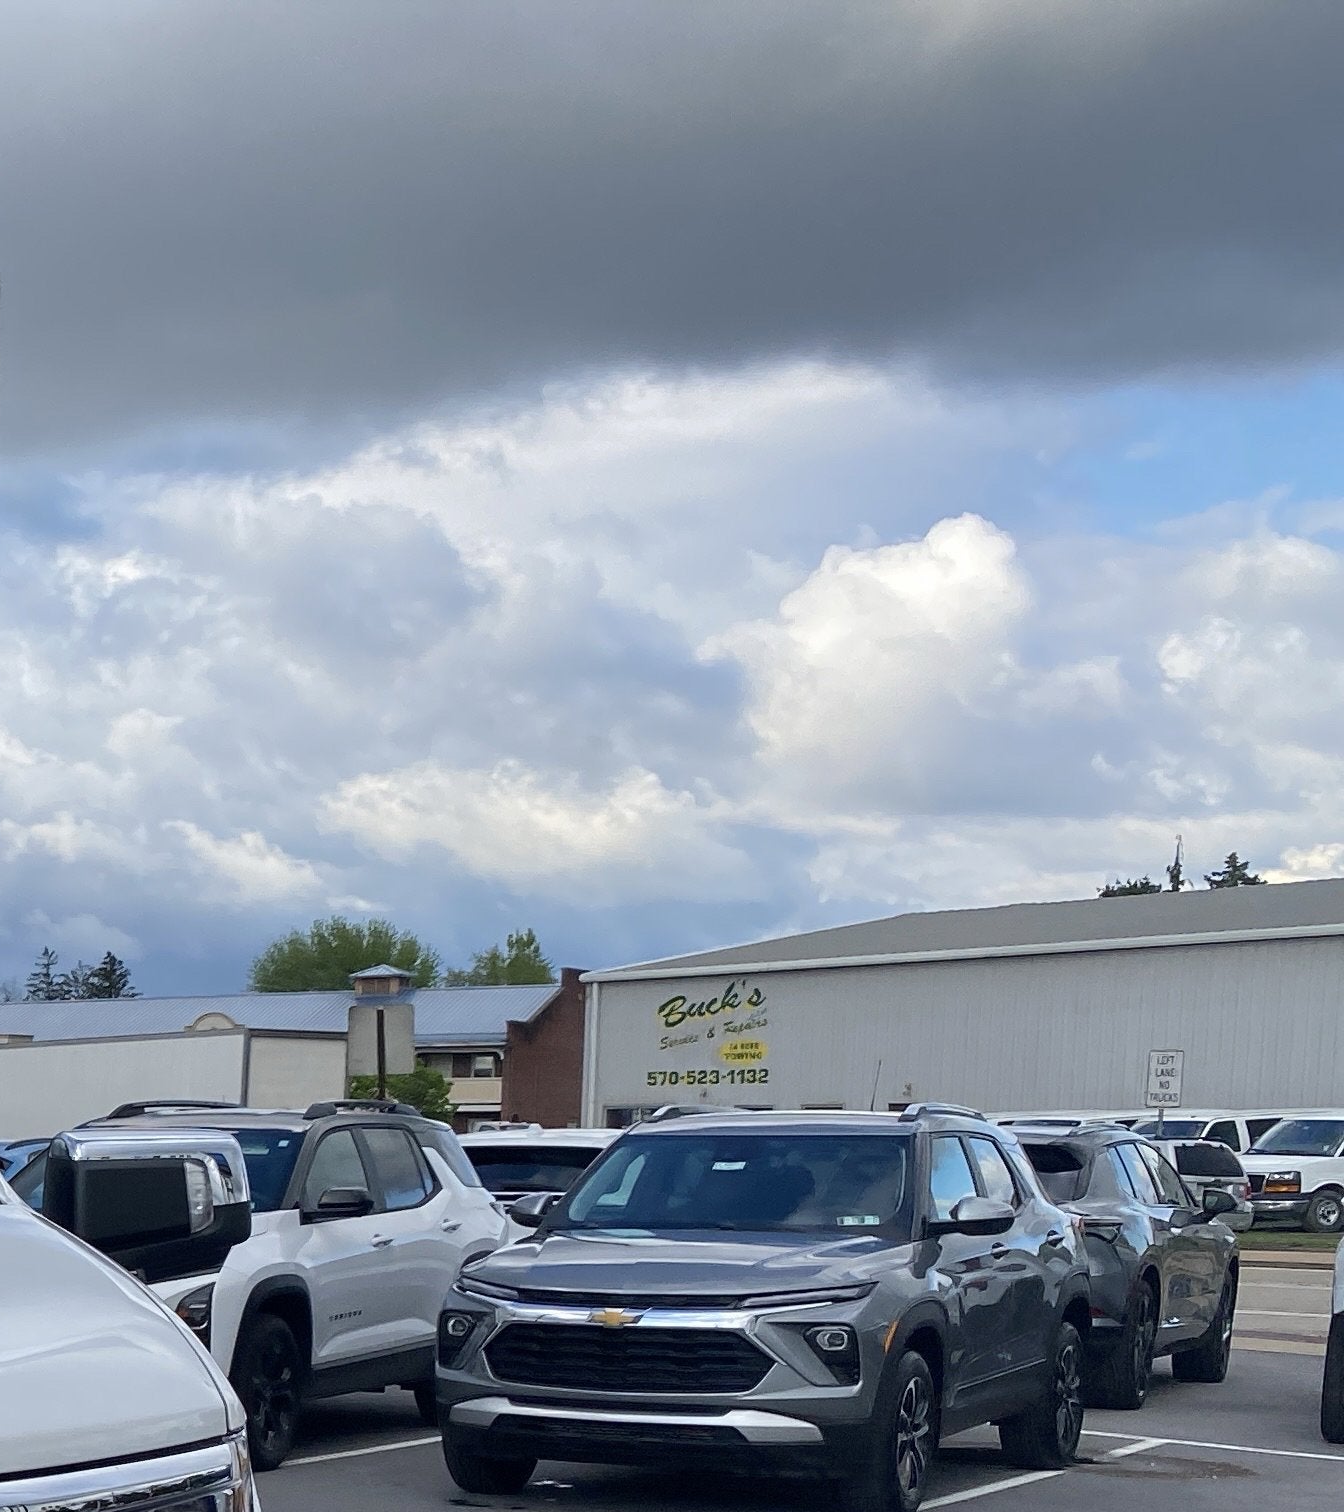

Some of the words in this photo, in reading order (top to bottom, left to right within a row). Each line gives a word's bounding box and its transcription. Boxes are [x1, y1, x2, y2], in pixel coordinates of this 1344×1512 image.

[657, 979, 767, 1028] Buck's
[1157, 1055, 1175, 1065] LEFT
[647, 1068, 769, 1086] 570-523-1132
[1155, 1067, 1175, 1078] LANE
[1159, 1080, 1170, 1090] NO
